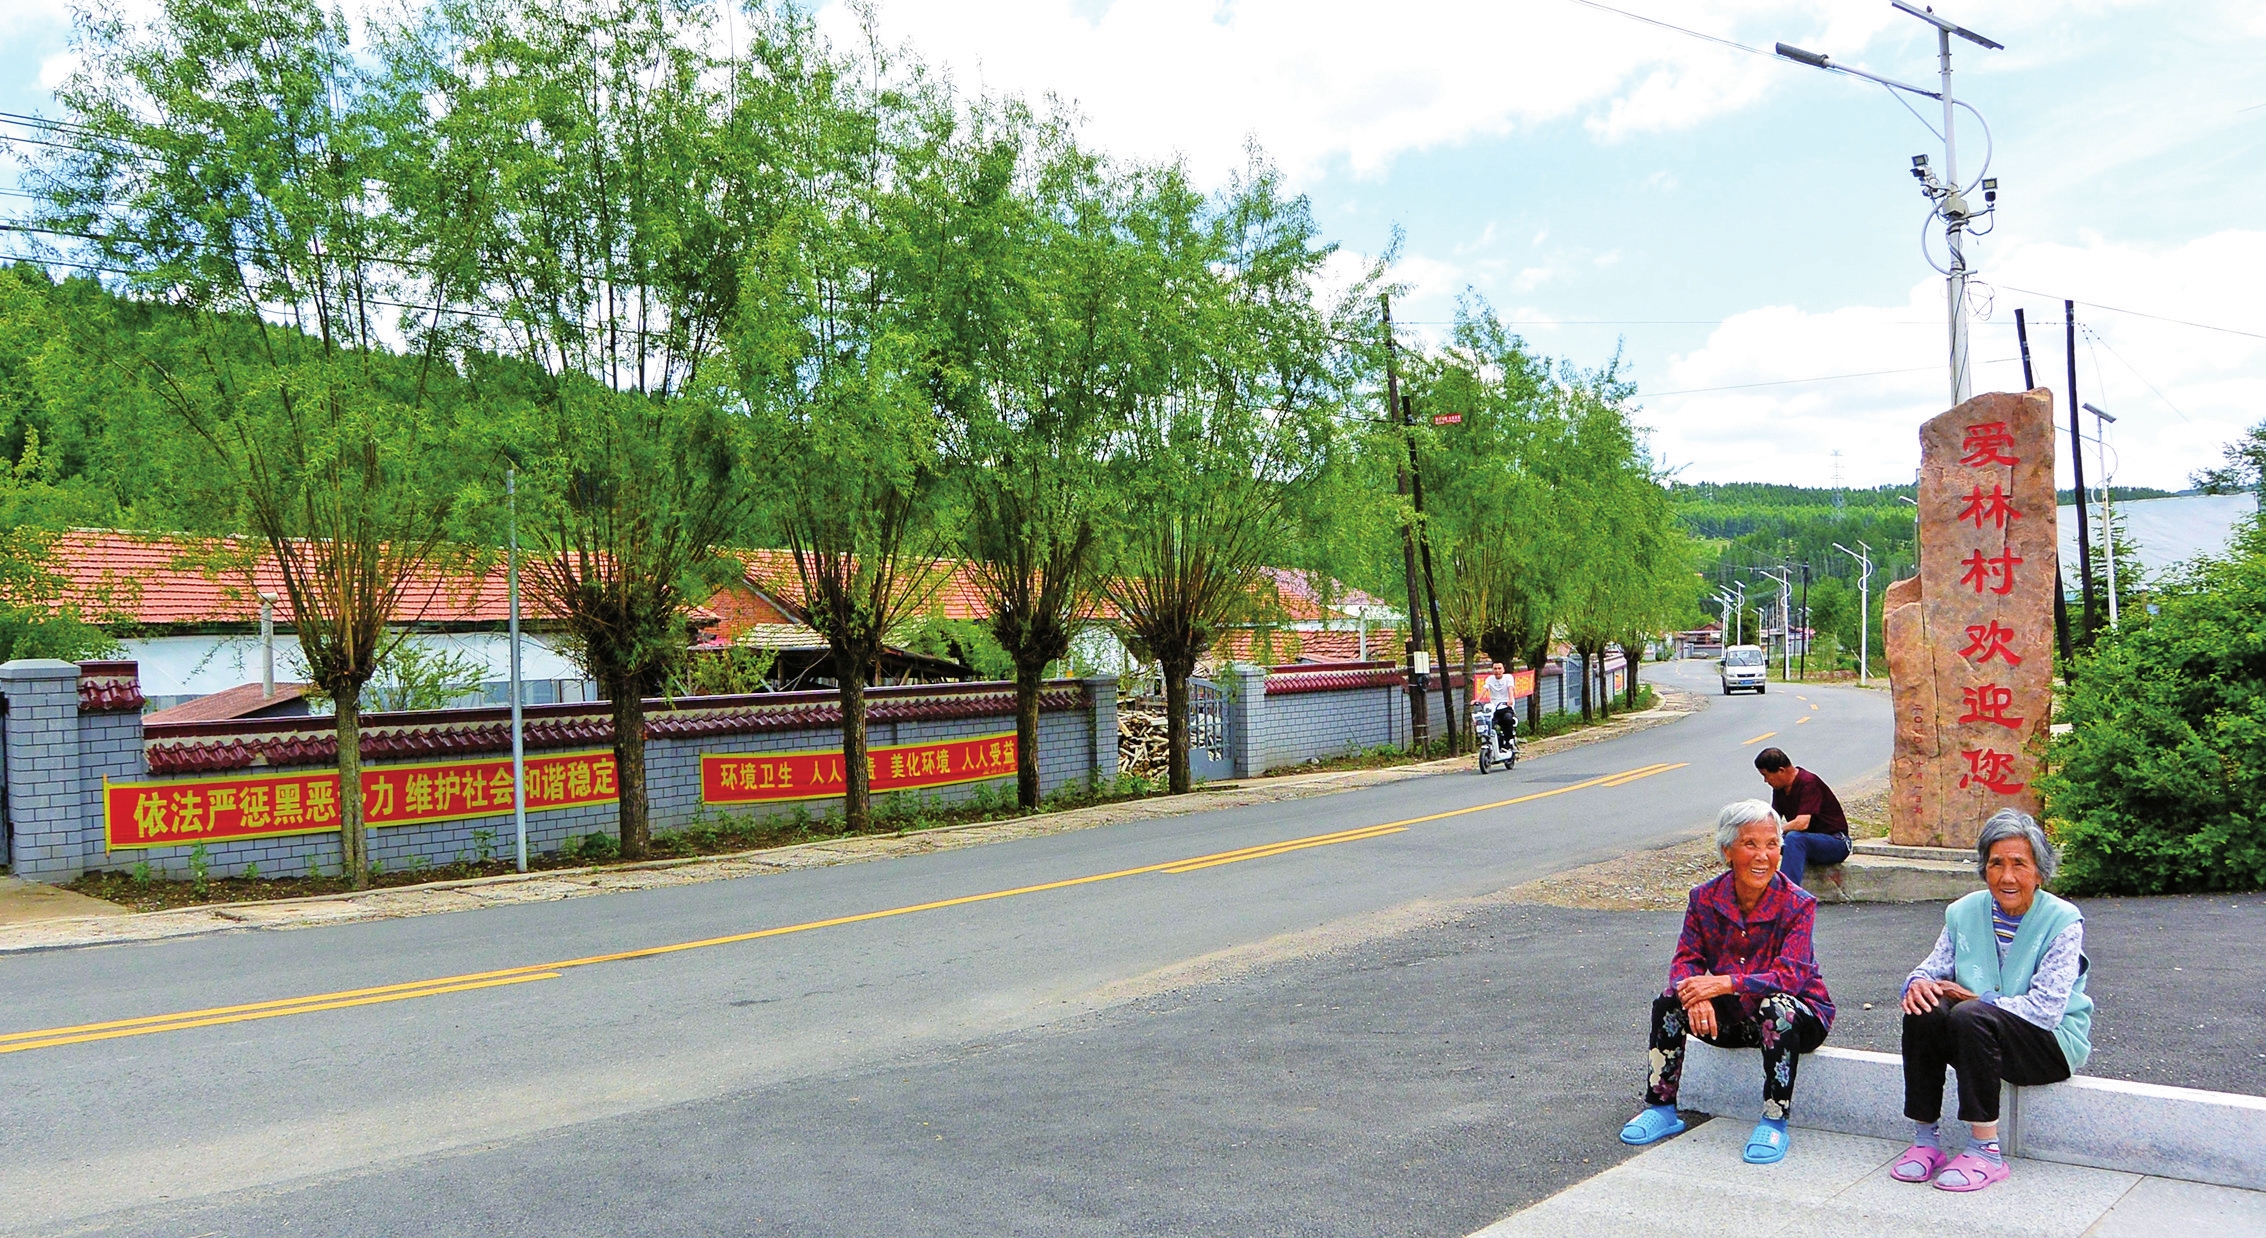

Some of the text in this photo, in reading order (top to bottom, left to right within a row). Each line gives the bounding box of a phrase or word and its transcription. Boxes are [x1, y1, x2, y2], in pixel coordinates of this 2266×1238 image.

[1959, 423, 2023, 795] 爱林村欢迎您
[134, 758, 615, 837] 依法严惩黑恶力 维护社会和谐稳定
[720, 739, 1016, 791] 环境卫生 人人责 美化环境 人人受益
